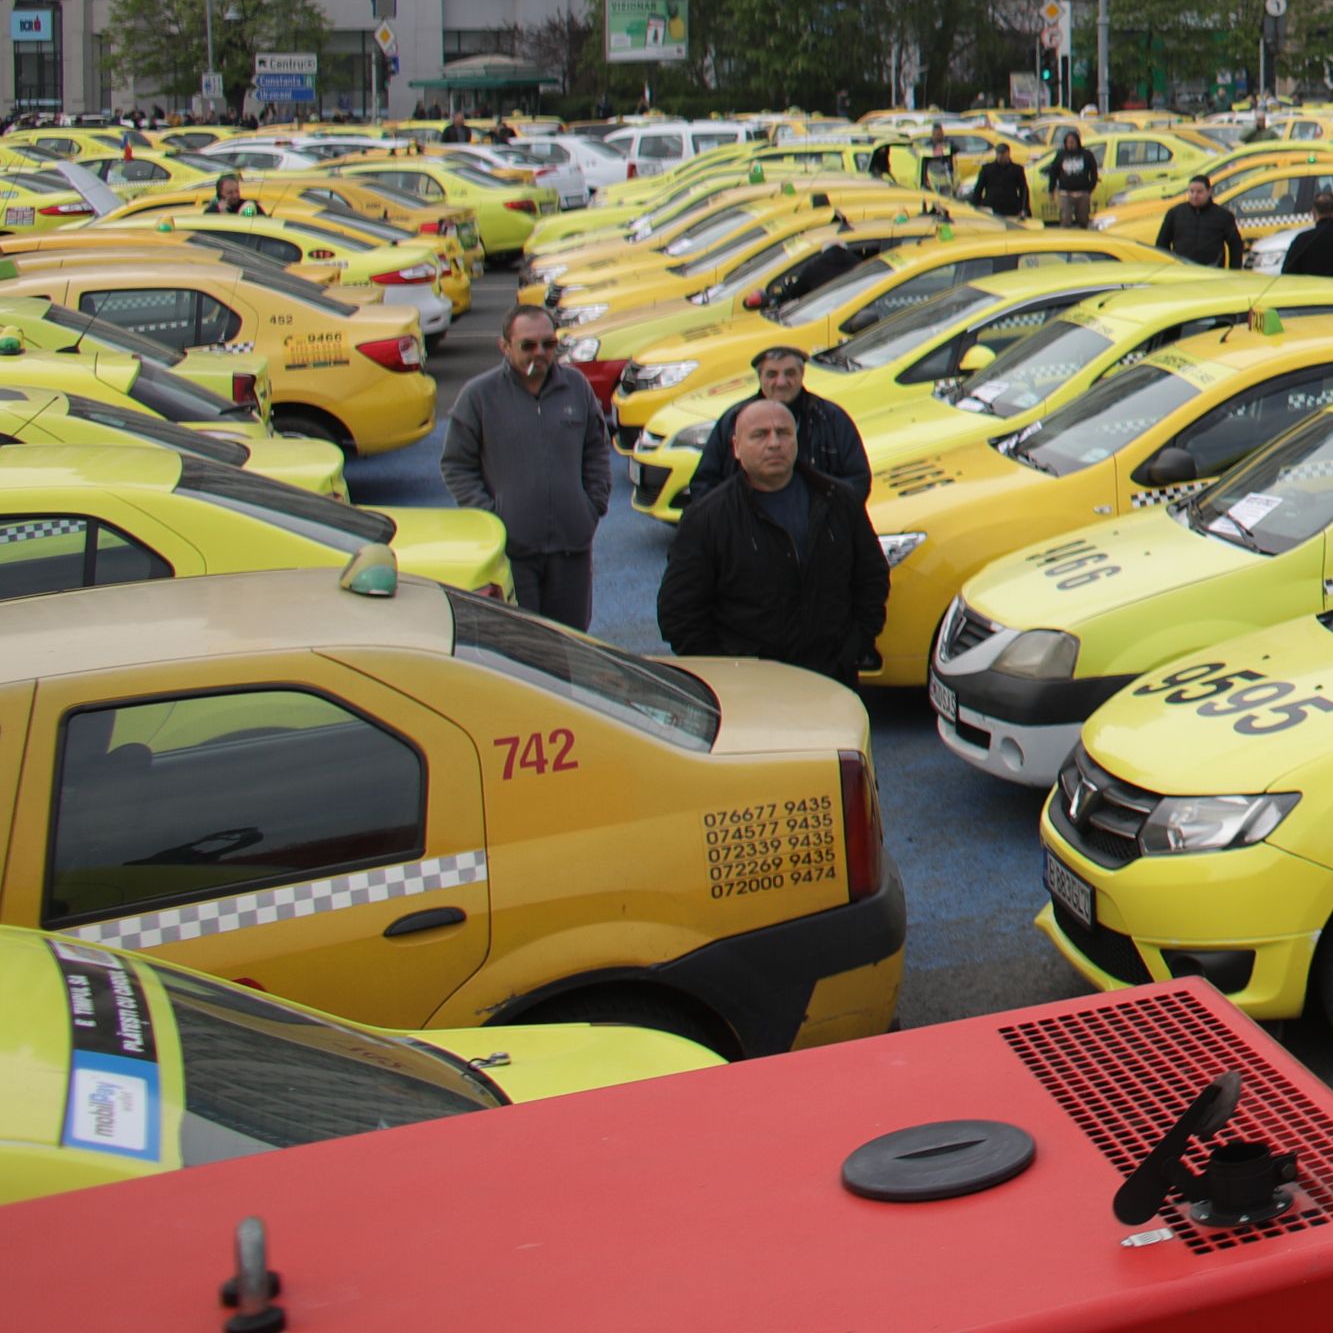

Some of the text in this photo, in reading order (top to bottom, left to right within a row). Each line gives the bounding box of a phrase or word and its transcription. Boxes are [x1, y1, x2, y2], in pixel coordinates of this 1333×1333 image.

[270, 314, 293, 326] 452
[493, 727, 579, 781] 742
[704, 795, 831, 828] 076677 9435
[706, 812, 833, 845] 074577 9435
[708, 829, 834, 863] 072339 9435
[710, 847, 835, 881] 072269 9435
[711, 865, 836, 899] 072000 9474
[70, 987, 95, 1016] TIMPUL
[115, 994, 138, 1009] CU
[75, 1019, 97, 1028] E
[88, 1081, 123, 1138] mobilPay
